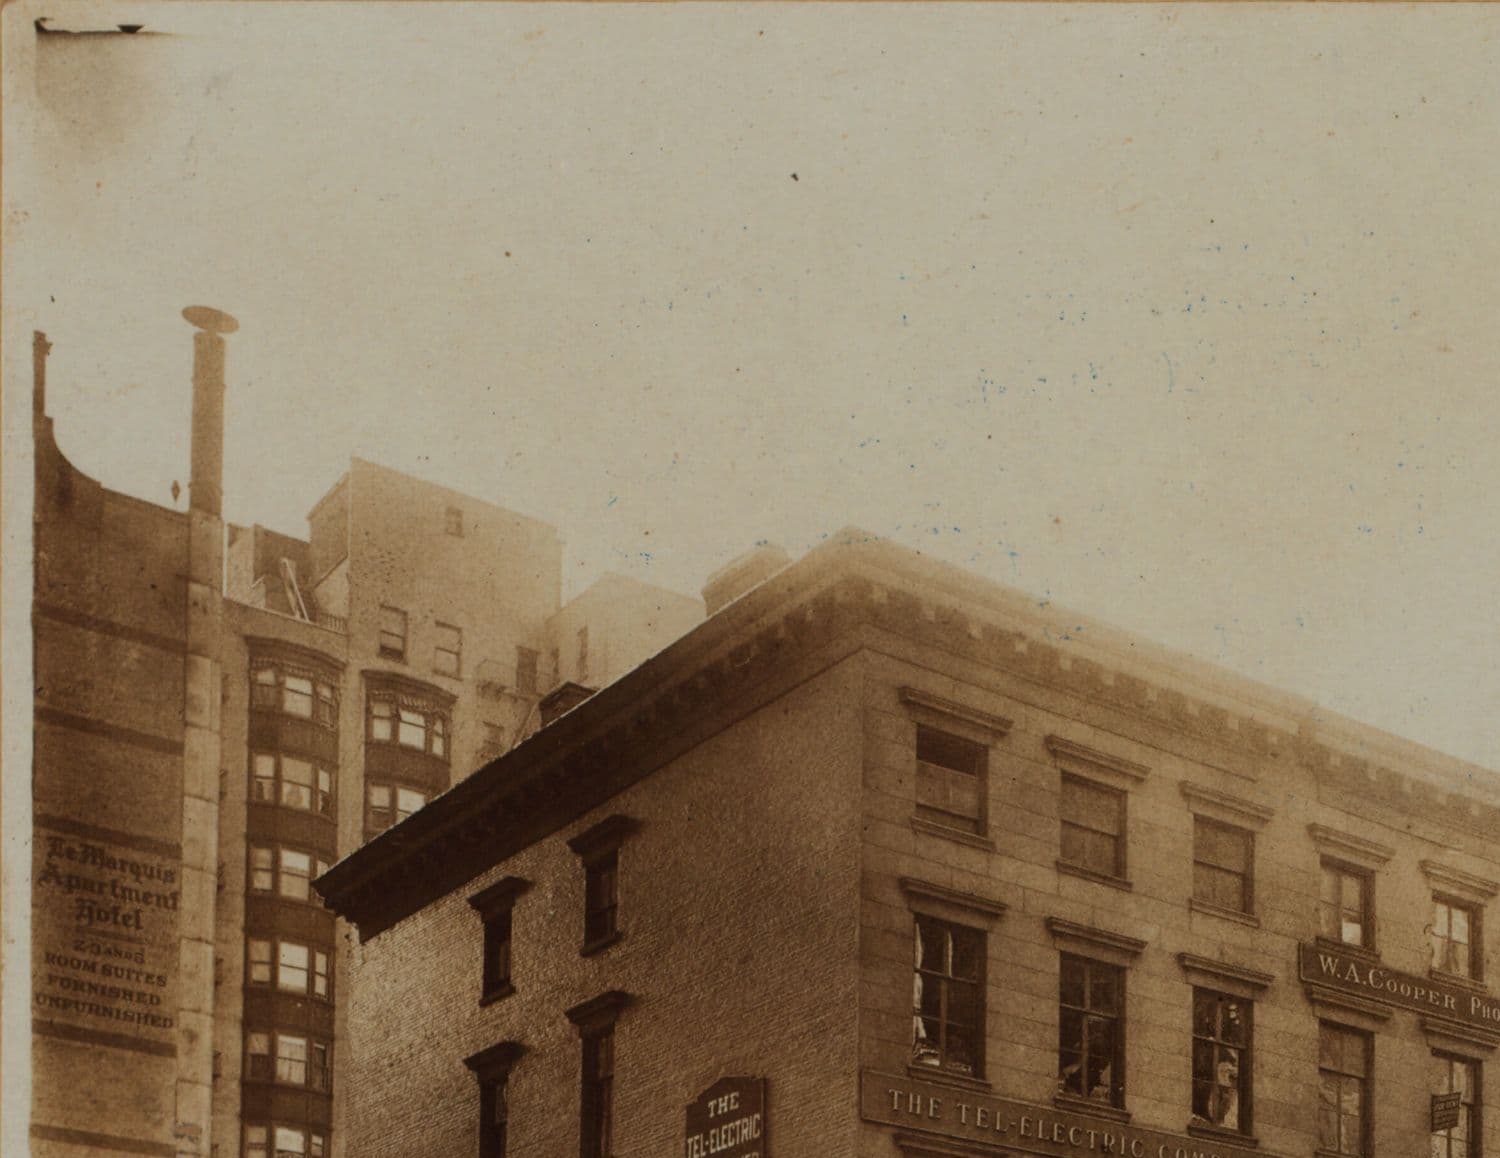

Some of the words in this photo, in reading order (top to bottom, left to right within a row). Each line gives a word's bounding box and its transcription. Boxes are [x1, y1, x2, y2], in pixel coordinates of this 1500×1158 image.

[44, 952, 98, 974] ROOM
[100, 963, 168, 988] SUITES
[46, 973, 163, 1008] FURNISHED
[35, 991, 175, 1030] UNFURNISHED
[707, 1091, 741, 1118] THE
[887, 1088, 944, 1121] THE
